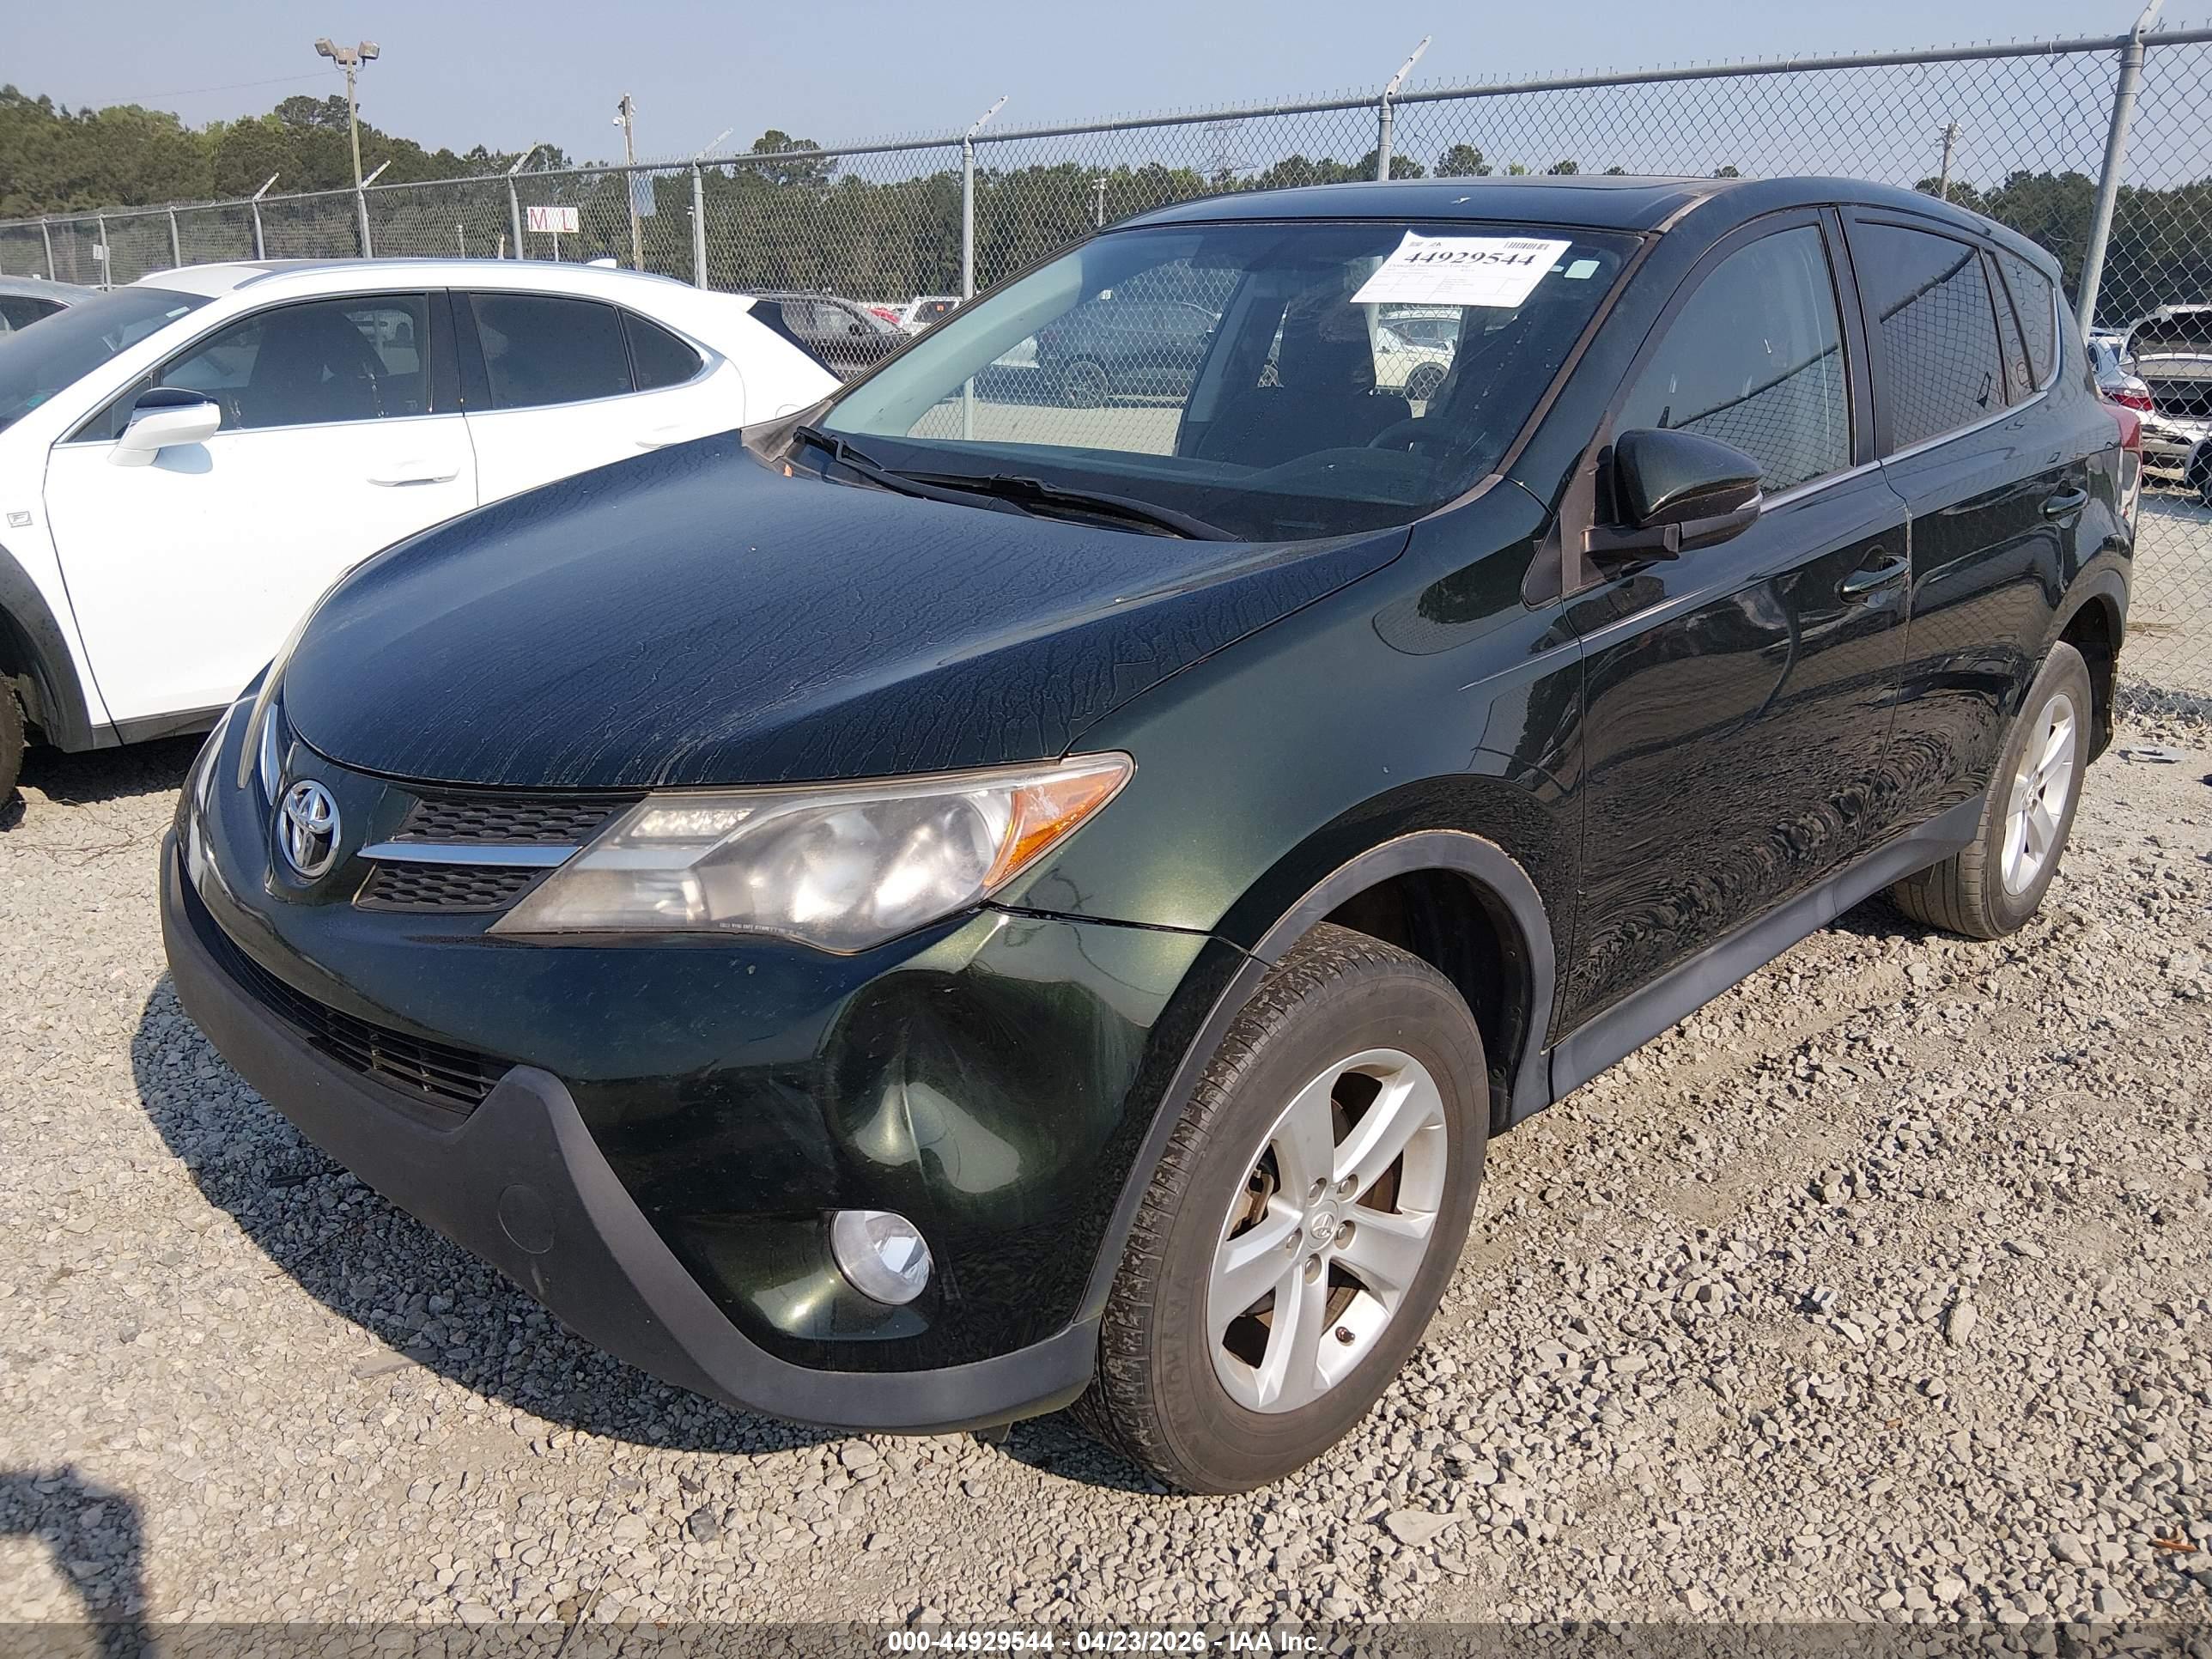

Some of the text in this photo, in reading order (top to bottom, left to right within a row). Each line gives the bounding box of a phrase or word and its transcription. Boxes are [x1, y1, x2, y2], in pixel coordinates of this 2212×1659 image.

[530, 208, 574, 231] M L
[1405, 252, 1535, 265] 44929544
